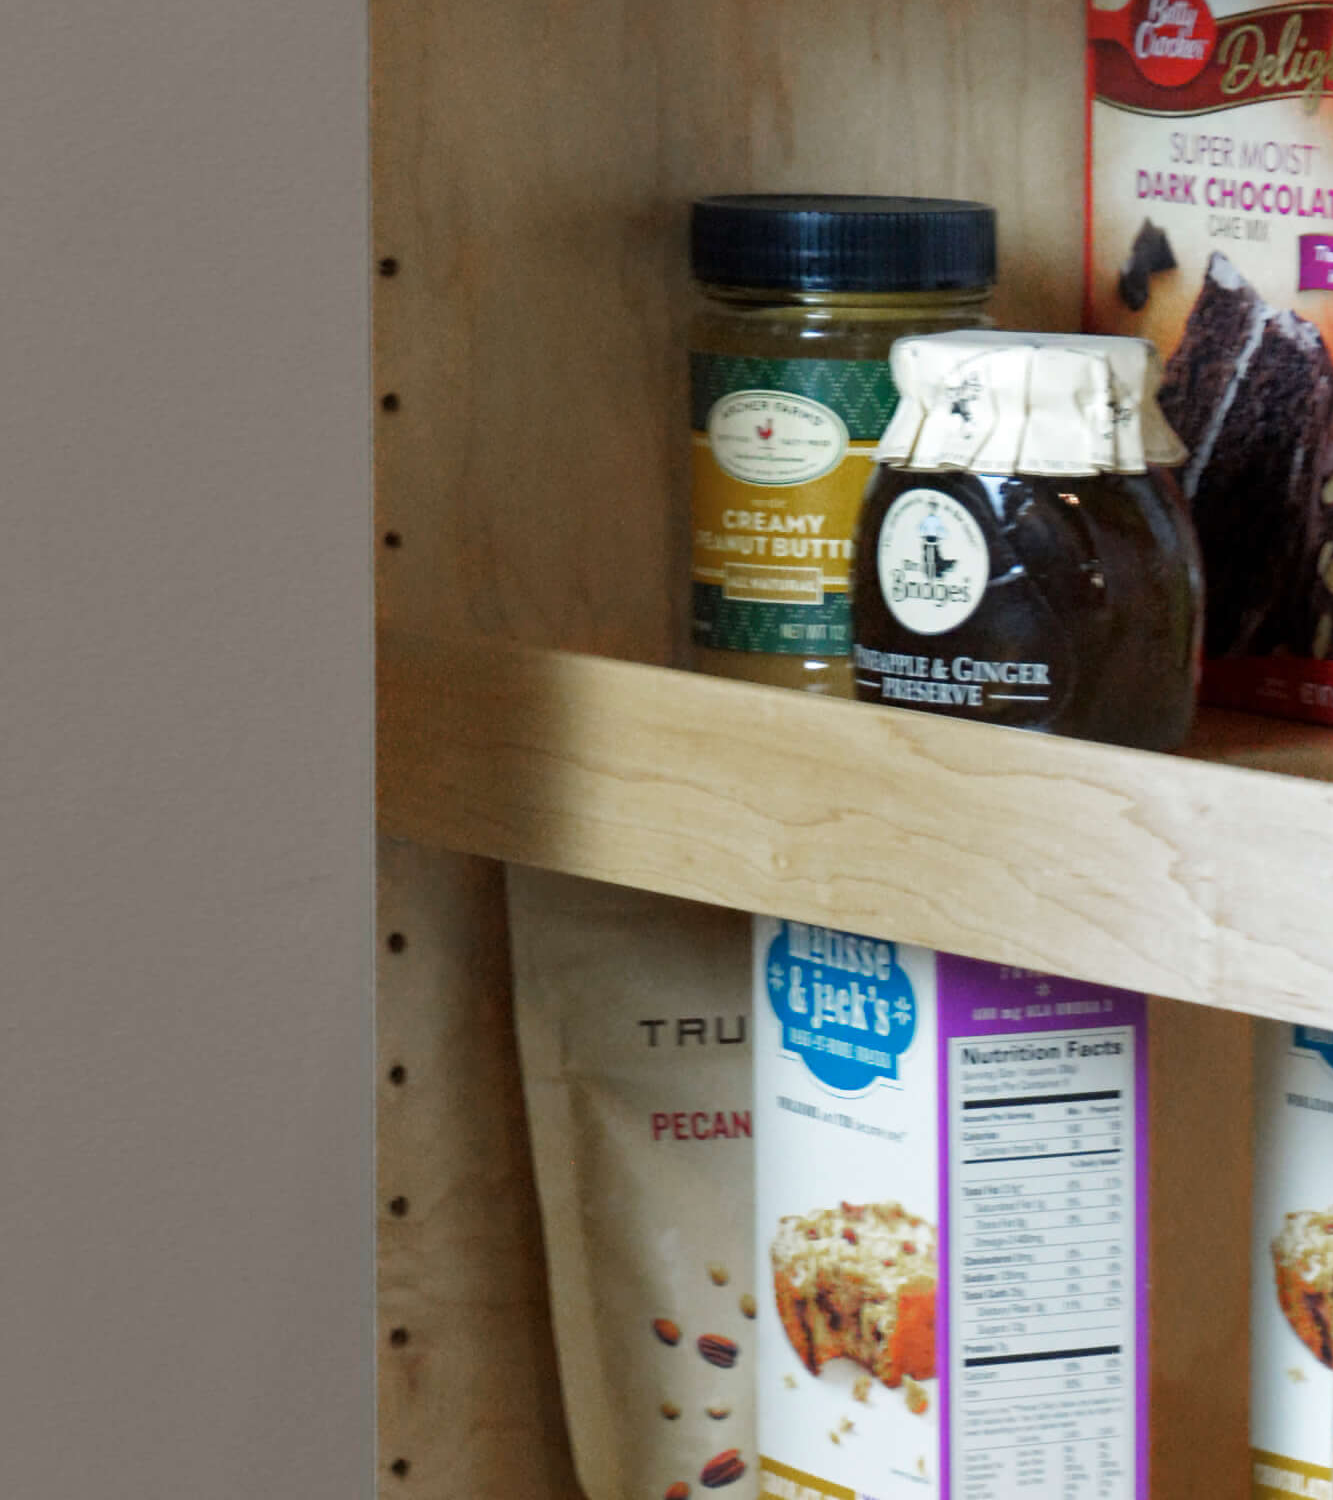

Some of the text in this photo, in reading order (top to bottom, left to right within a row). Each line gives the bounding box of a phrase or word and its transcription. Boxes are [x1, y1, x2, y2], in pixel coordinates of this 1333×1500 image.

[1169, 131, 1320, 176] SUPER MOIST
[1135, 168, 1198, 205] DARK
[722, 509, 826, 535] CREAMY
[951, 656, 1050, 685] GINGER
[961, 1040, 1123, 1066] Nutrition Facts
